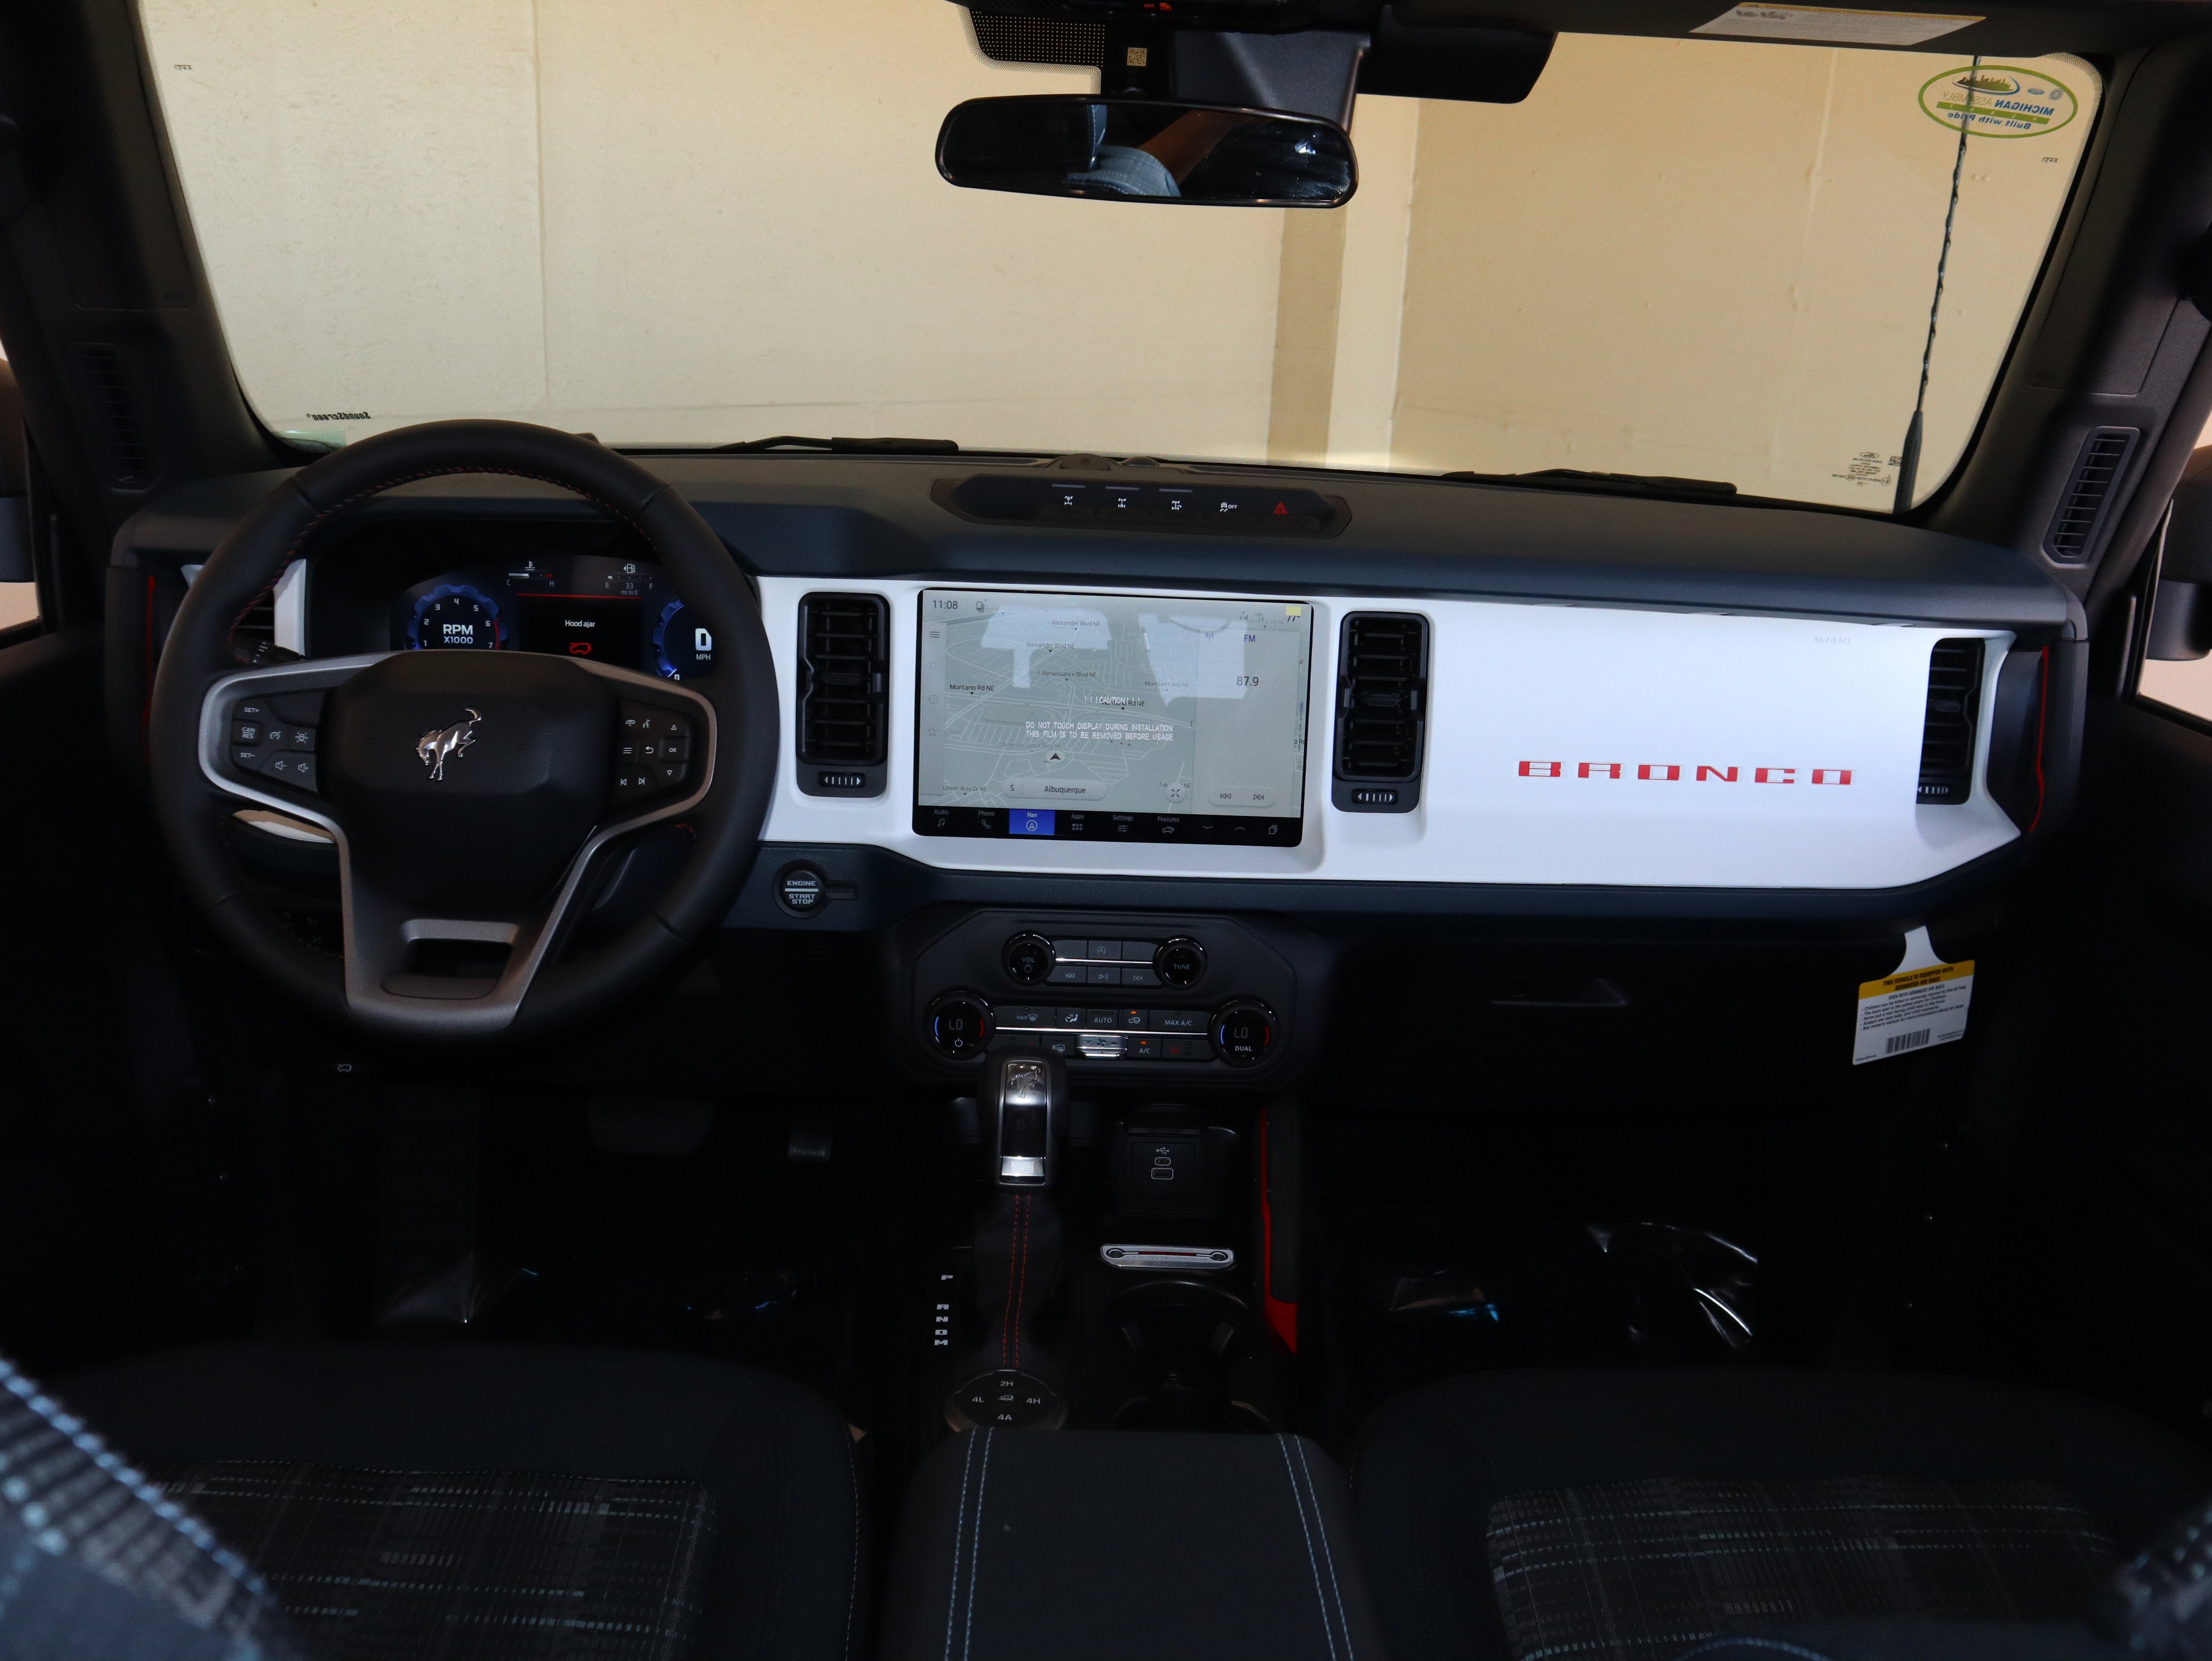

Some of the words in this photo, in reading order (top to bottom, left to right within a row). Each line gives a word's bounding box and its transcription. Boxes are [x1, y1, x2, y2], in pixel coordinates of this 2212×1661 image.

[932, 600, 958, 610] 11:08
[443, 624, 473, 635] RPM
[444, 636, 473, 644] X1000
[695, 627, 712, 652] 0
[1236, 676, 1259, 686] 87.9
[1518, 760, 1853, 786] BRONCO
[1044, 785, 1086, 795] Albuquerque
[949, 1019, 963, 1030] LO
[1234, 1026, 1248, 1039] LO
